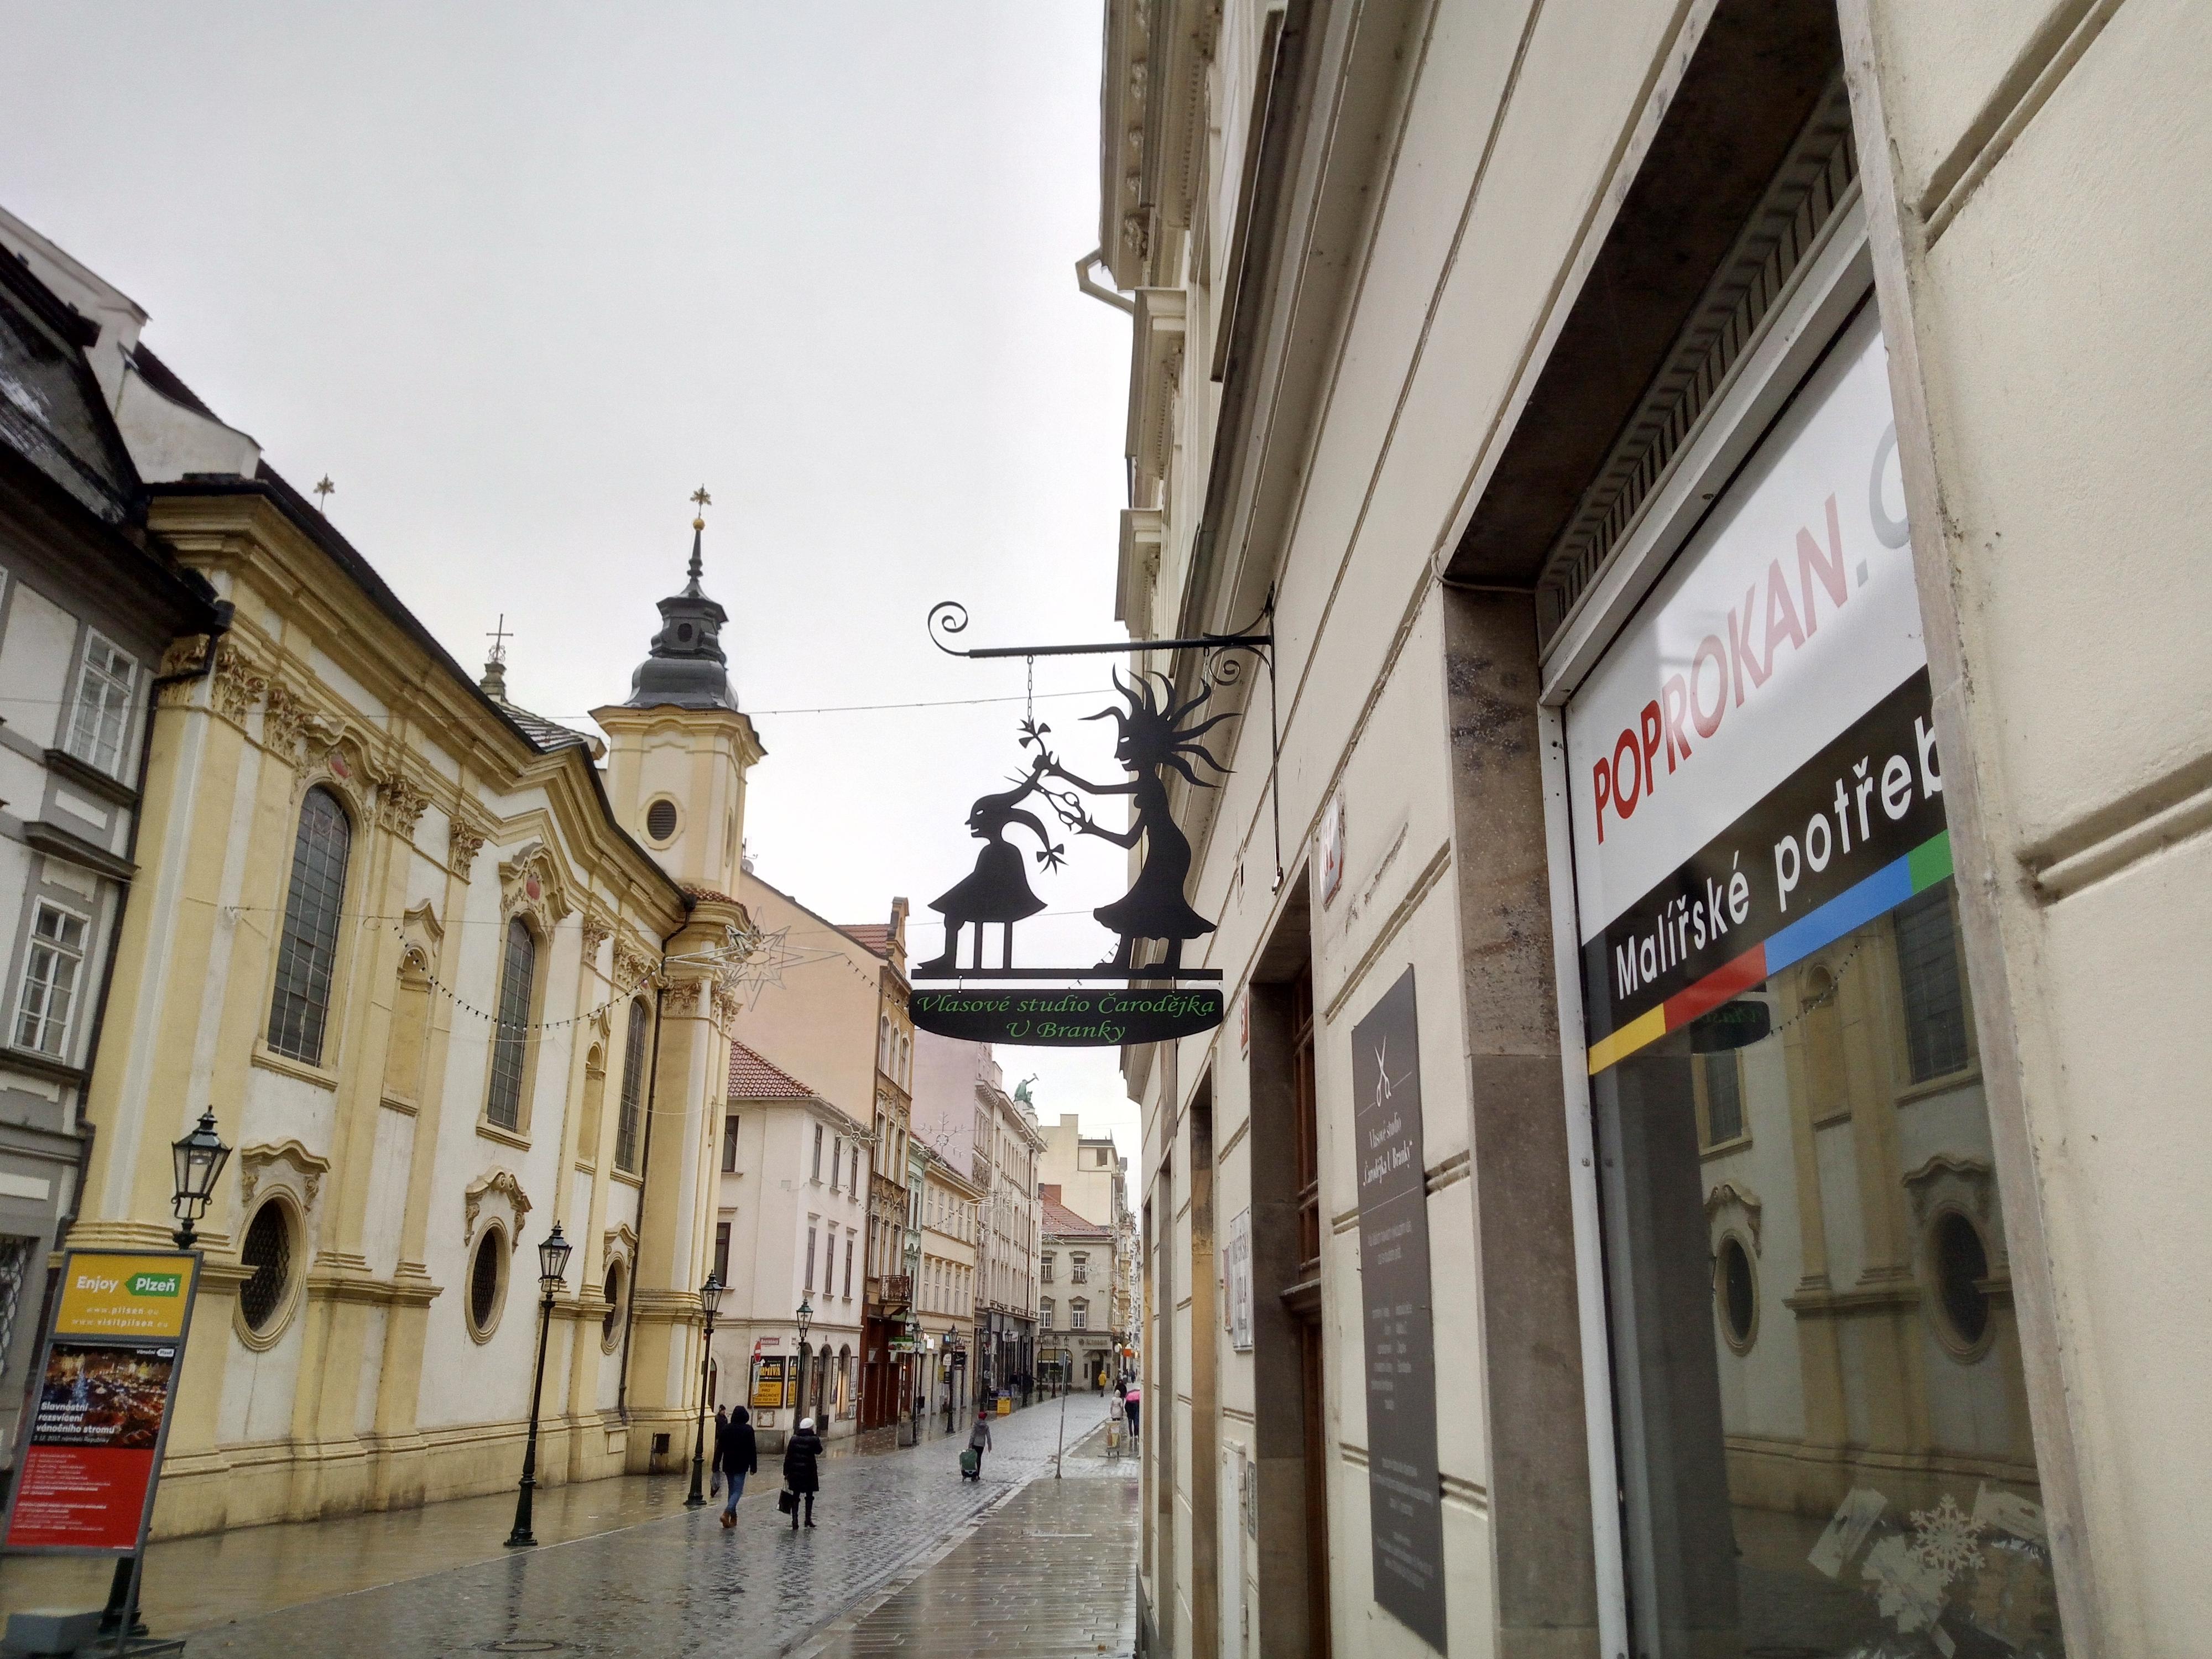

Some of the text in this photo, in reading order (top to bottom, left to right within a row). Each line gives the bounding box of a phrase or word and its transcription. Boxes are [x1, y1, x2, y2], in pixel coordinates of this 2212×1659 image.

[1615, 850, 1750, 1000] Malířské
[917, 992, 1215, 1017] Vlasové studio Čarodějka
[1006, 1020, 1126, 1044] U Branky
[76, 1275, 175, 1293] Enjoy Plzeň
[36, 1423, 115, 1433] vánočního stromu
